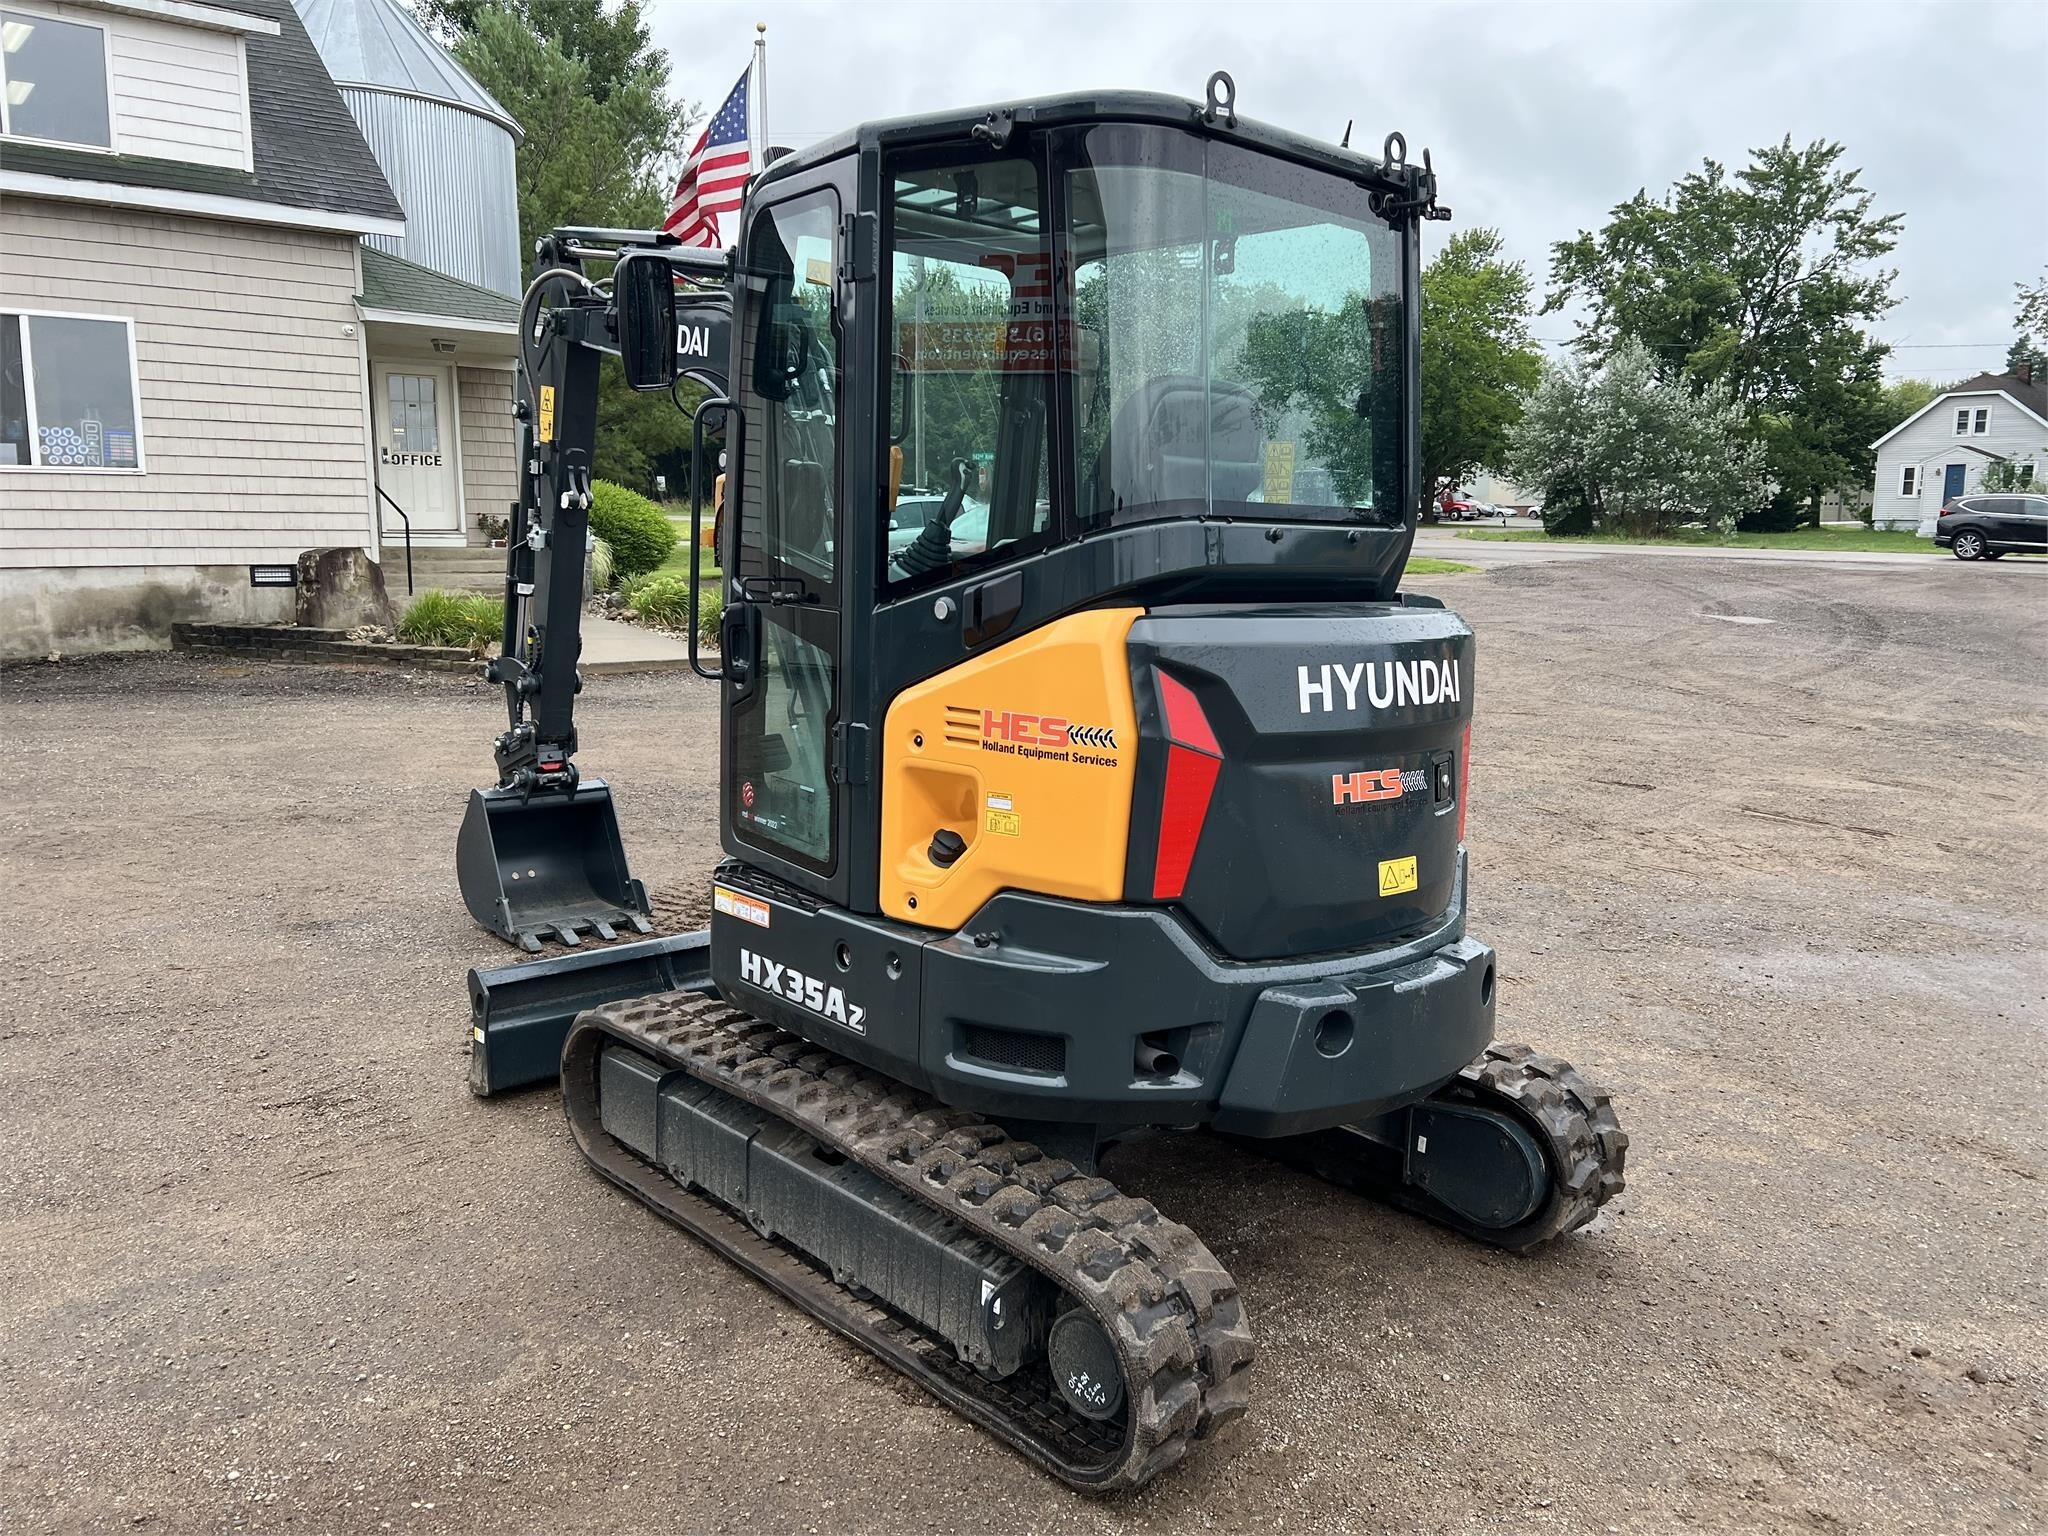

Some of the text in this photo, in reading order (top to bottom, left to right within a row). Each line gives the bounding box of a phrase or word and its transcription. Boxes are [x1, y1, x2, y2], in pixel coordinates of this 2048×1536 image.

[391, 454, 442, 466] OFFICE
[1298, 660, 1460, 713] HYUNDAI
[983, 710, 1069, 748] HES
[982, 740, 1118, 767] Holland Equipment Services
[1332, 768, 1403, 805] HES
